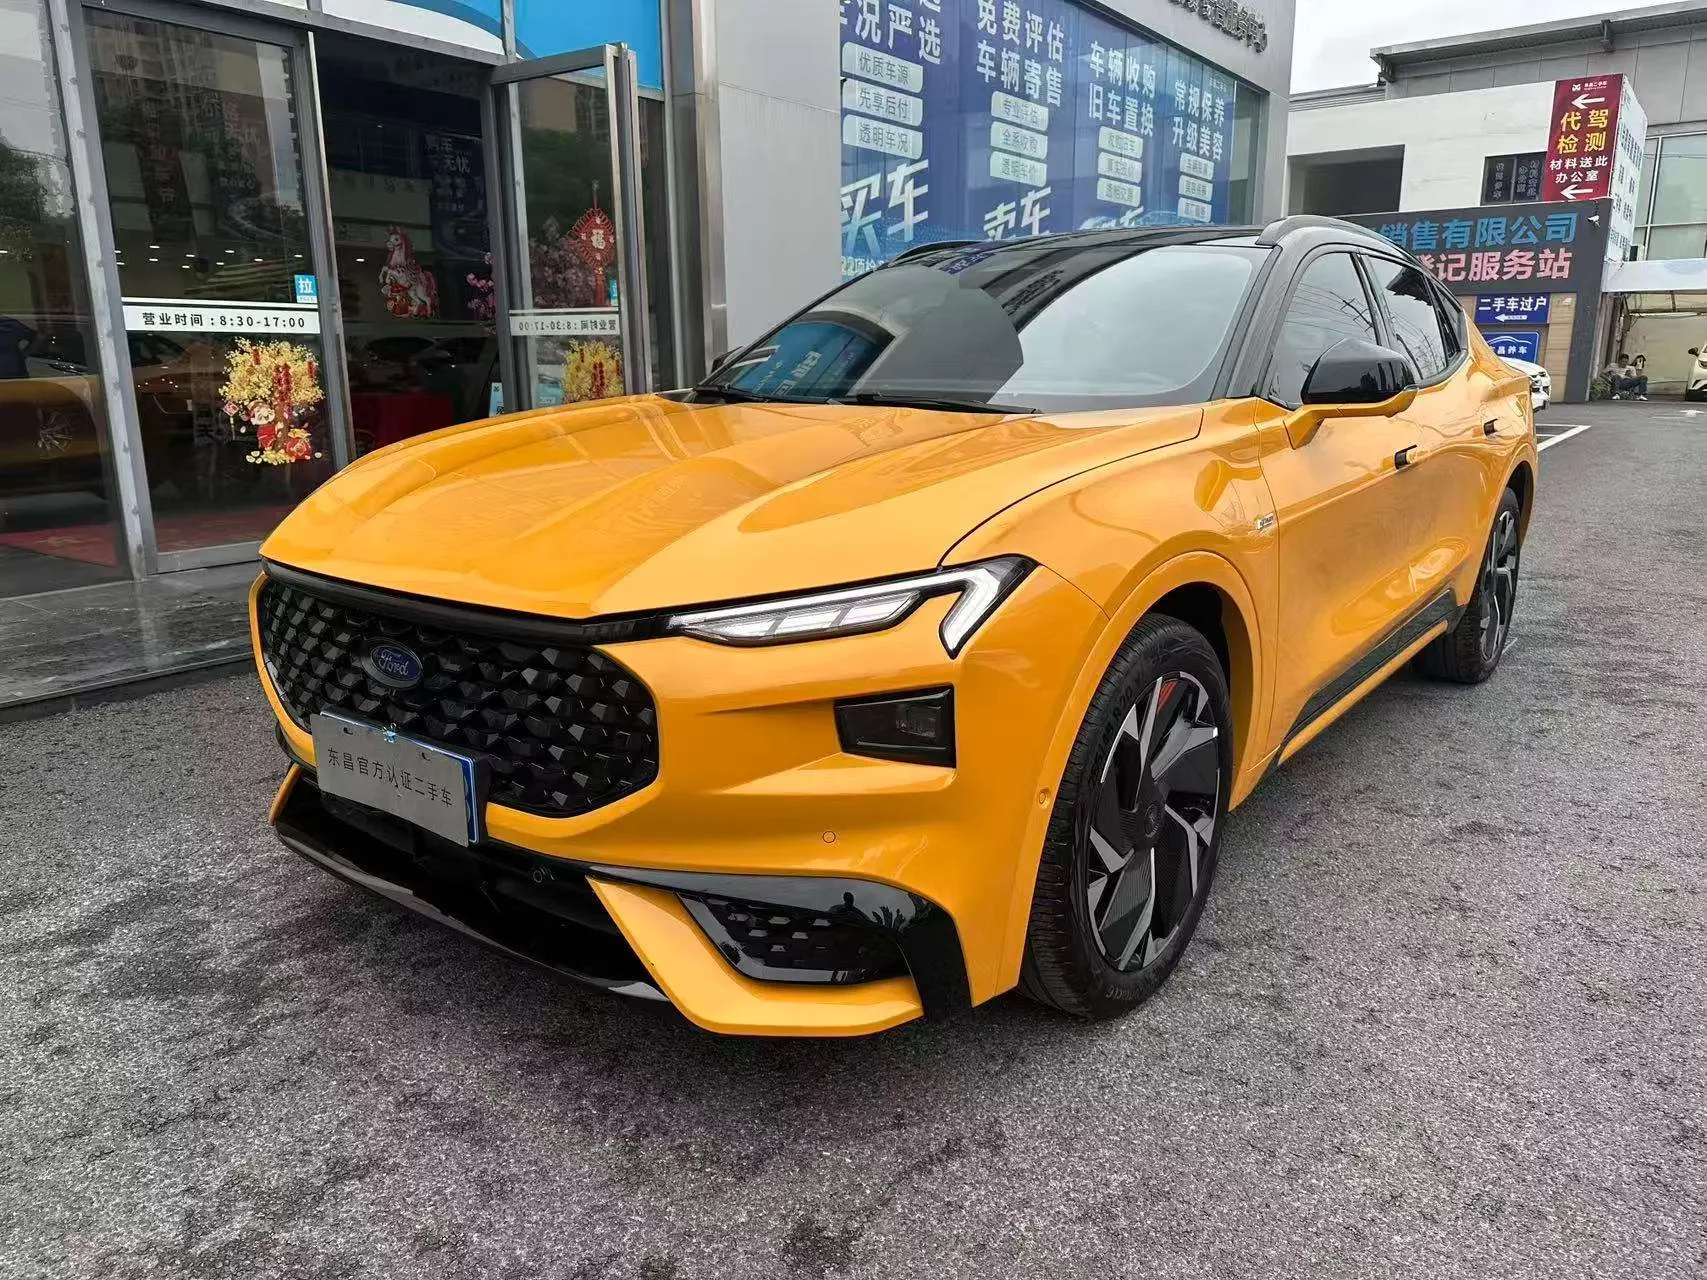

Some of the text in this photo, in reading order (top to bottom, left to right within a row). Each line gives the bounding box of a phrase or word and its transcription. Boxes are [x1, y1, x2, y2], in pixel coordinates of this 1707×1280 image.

[840, 0, 941, 64] 况严选
[977, 0, 1064, 62] 免费评估
[858, 51, 909, 86] 优质车源
[976, 40, 1062, 107] 车辆寄售
[1090, 40, 1155, 98] 车辆收购
[858, 88, 909, 119] 先享后付
[1088, 83, 1154, 137] 旧车置换
[1175, 79, 1225, 127] 常规保养
[1560, 109, 1609, 131] 代驾
[858, 122, 909, 154] 透明车况
[1172, 116, 1224, 160] 升级美容
[1556, 131, 1607, 155] 检测
[1549, 155, 1609, 171] 材料送此
[1555, 170, 1600, 184] 办公室
[840, 159, 928, 257] 买车
[1379, 212, 1580, 251] 销售有限公司
[298, 277, 313, 294] 拉
[1478, 296, 1548, 313] 二手车过户
[378, 649, 409, 676] Ford
[327, 747, 453, 807] 东昌官方认证二手车
